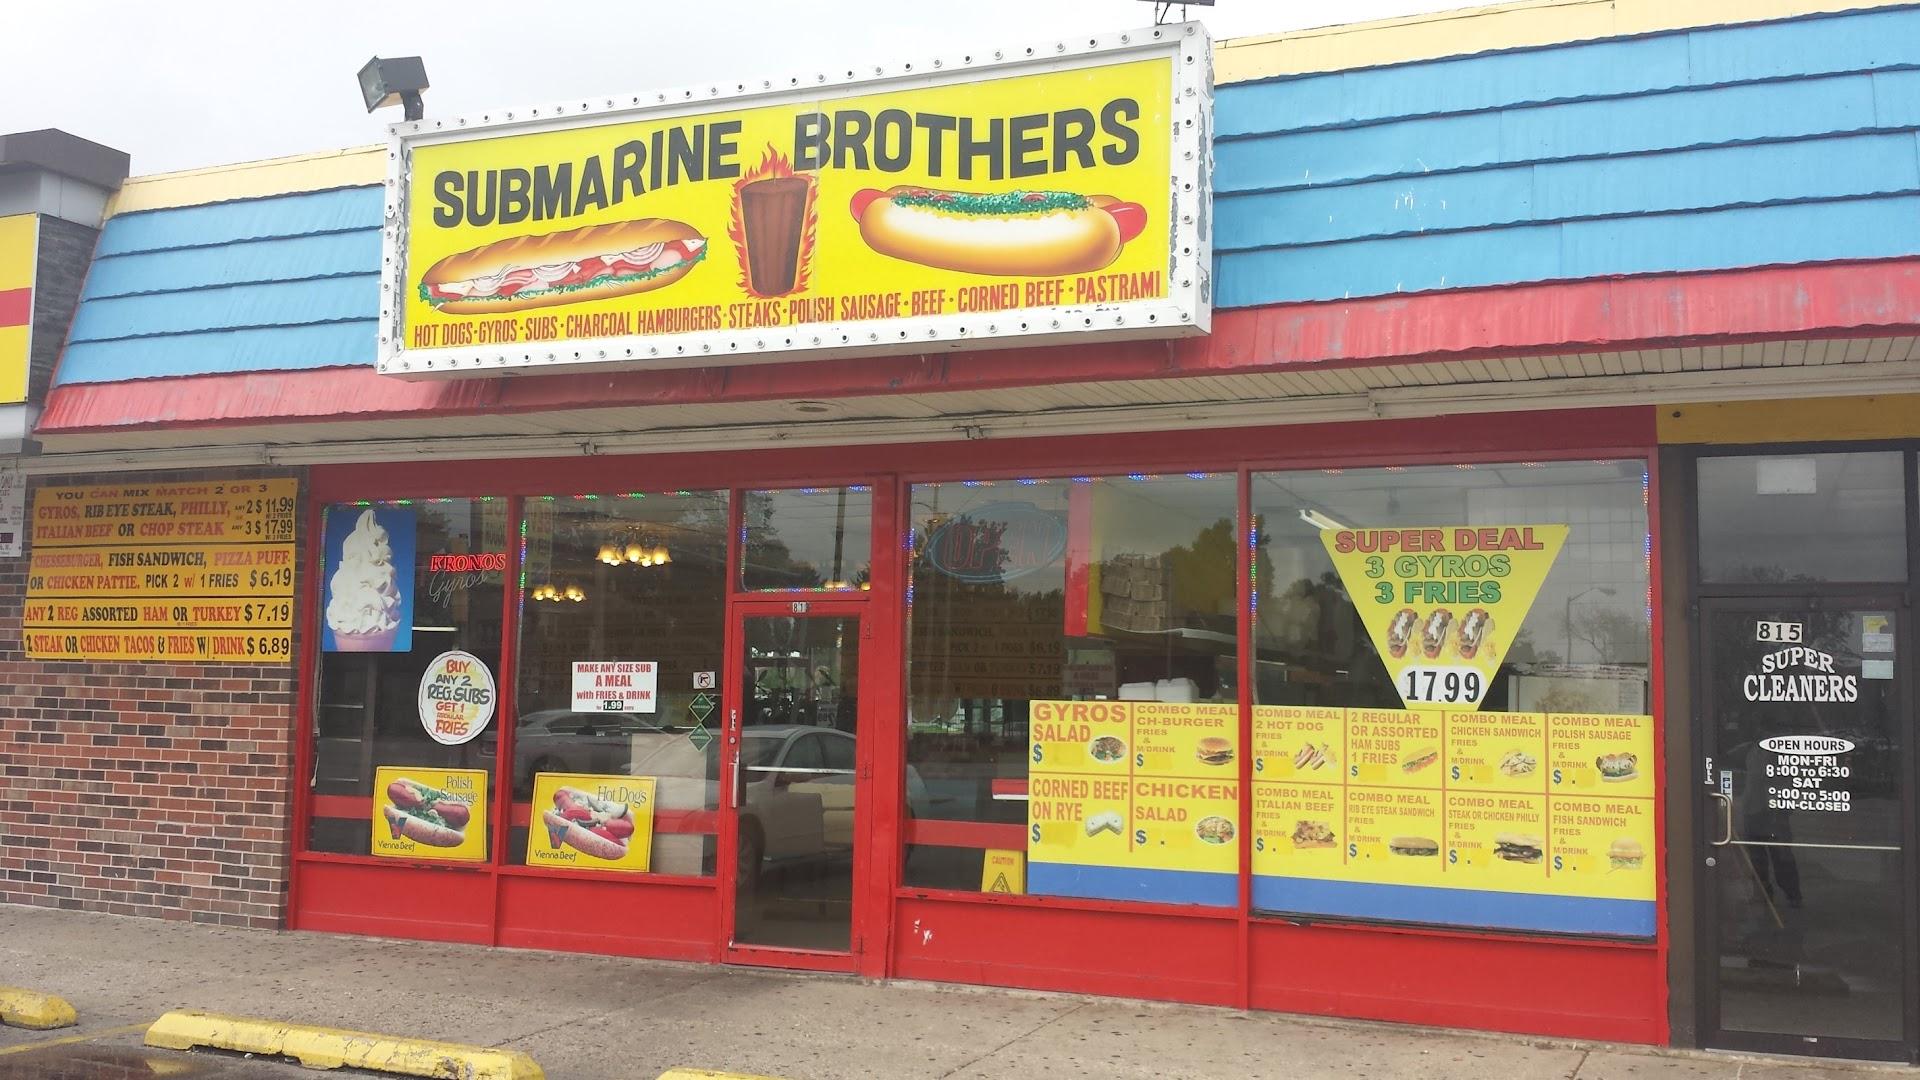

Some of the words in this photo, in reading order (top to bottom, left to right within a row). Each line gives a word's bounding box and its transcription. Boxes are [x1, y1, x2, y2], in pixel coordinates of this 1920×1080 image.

[433, 121, 742, 228] SUBMARINE
[794, 98, 1140, 181] BROTHERS
[415, 324, 437, 347] HOT
[526, 317, 557, 340] SUBS
[566, 313, 633, 338] CHARCOAL
[638, 306, 722, 334] HAMBURGERS
[729, 304, 781, 328] STEAKS
[789, 296, 835, 324] POLISH
[841, 293, 901, 321] SAUSAGE
[912, 289, 945, 315] BEEF
[958, 284, 1019, 312] CORNED
[1025, 279, 1065, 308] BEEF
[1075, 271, 1160, 303] PASTRAMI
[56, 492, 84, 500] YOU
[90, 490, 118, 498] CAN
[123, 488, 149, 497] MIX
[155, 486, 208, 496] MATCH
[131, 502, 176, 517] STEAK,
[180, 501, 230, 516] PHILLY,
[36, 524, 84, 539] ITALIAN
[86, 523, 113, 537] BEEF
[118, 524, 134, 536] OR
[140, 522, 174, 536] CHOP
[177, 521, 224, 534] STEAK
[1335, 529, 1445, 553] SUPER
[1455, 528, 1543, 551] DEAL
[108, 553, 134, 567] FISH
[137, 551, 207, 569] SANDWICH,
[214, 551, 253, 567] PIZZA
[430, 554, 506, 572] KRONOS
[1365, 556, 1385, 578] 3
[1394, 554, 1511, 578] GYROS
[30, 576, 43, 590] OR
[47, 575, 94, 590] CHICKEN
[146, 574, 168, 588] PICK
[209, 573, 239, 588] FRIES
[429, 569, 487, 609] Gyros
[1375, 581, 1394, 603] 3
[1405, 581, 1501, 603] FRIES
[25, 607, 45, 622] ANY
[57, 607, 78, 621] REG
[82, 606, 137, 621] ASSORTED
[143, 606, 168, 621] HAM
[173, 606, 188, 621] OR
[193, 605, 241, 621] TURKEY
[1758, 623, 1800, 641] 815
[34, 635, 63, 651] STEAK
[65, 636, 77, 653] OR
[80, 635, 120, 653] CHICKEN
[124, 635, 154, 653] TACOS
[168, 635, 194, 654] FRIES
[213, 637, 245, 654] DRINK
[447, 659, 471, 673] BUY
[1762, 647, 1835, 674] SUPER
[577, 664, 599, 672] MAKE
[600, 664, 616, 672] ANY
[617, 664, 633, 672] SIZE
[635, 664, 651, 672] SUB
[436, 674, 458, 685] ANY
[461, 676, 472, 686] 2
[595, 675, 602, 687] A
[604, 675, 632, 687] MEAL
[1406, 670, 1480, 703] 17.99
[576, 691, 594, 699] with
[595, 691, 617, 700] FRIES
[626, 691, 650, 700] DRINK
[1744, 675, 1858, 702] CLEANERS
[436, 702, 458, 712] GET
[603, 701, 623, 710] 1.99
[1137, 705, 1191, 715] COMBO
[1196, 706, 1237, 716] MEAL
[1033, 703, 1126, 723] GYROS
[1256, 709, 1301, 718] COMBO
[1306, 711, 1340, 719] MEAL
[1362, 713, 1420, 724] REGULAR
[1451, 715, 1496, 724] COMBO
[1501, 716, 1536, 725] MEAL
[436, 720, 470, 735] FRIES
[1137, 717, 1224, 727] CH-BURGER
[1267, 721, 1292, 730] HOT
[1297, 722, 1324, 731] DOG
[1553, 717, 1599, 726] COMBO
[1605, 718, 1640, 728] MEAL
[1033, 725, 1091, 742] SALAD
[1351, 726, 1369, 737] OR
[1372, 727, 1438, 738] ASSORTED
[1451, 727, 1490, 736] CHICKEN
[1493, 728, 1541, 738] SANDWICH
[1553, 730, 1585, 739] POLISH
[1588, 730, 1631, 740] SAUSAGE
[1351, 740, 1372, 750] HAM
[1375, 740, 1400, 751] SUBS
[1769, 740, 1800, 750] OPEN
[1804, 740, 1845, 751] HOURS
[1362, 753, 1397, 765] FRIES
[1778, 756, 1837, 766] MON-FRI
[1819, 767, 1849, 777] 6:30
[446, 775, 473, 790] Polish
[1033, 778, 1088, 798] CORNED
[1094, 781, 1128, 800] BEEF
[1792, 778, 1822, 788] SAT
[440, 789, 478, 803] Sausage
[597, 786, 616, 801] Hot
[619, 787, 647, 809] Dogs
[1136, 783, 1237, 800] CHICKEN
[1819, 791, 1850, 801] 5:00
[1033, 802, 1051, 820] ON
[1056, 803, 1082, 821] RYE
[1257, 800, 1301, 810] ITALIAN
[1306, 802, 1335, 812] BEEF
[1361, 806, 1374, 814] EYE
[1376, 806, 1397, 815] STEAK
[1400, 807, 1434, 817] SANDWICH
[1769, 800, 1850, 811] SUN-CLOSED
[1135, 806, 1187, 822] SALAD
[1449, 809, 1471, 819] STEAK
[1472, 811, 1482, 820] OR
[1484, 811, 1514, 821] CHICKEN
[1516, 813, 1539, 823] PHILLY
[1554, 815, 1574, 825] FISH
[1577, 816, 1626, 827] SANDWICH
[992, 856, 1014, 865] CAUTION
